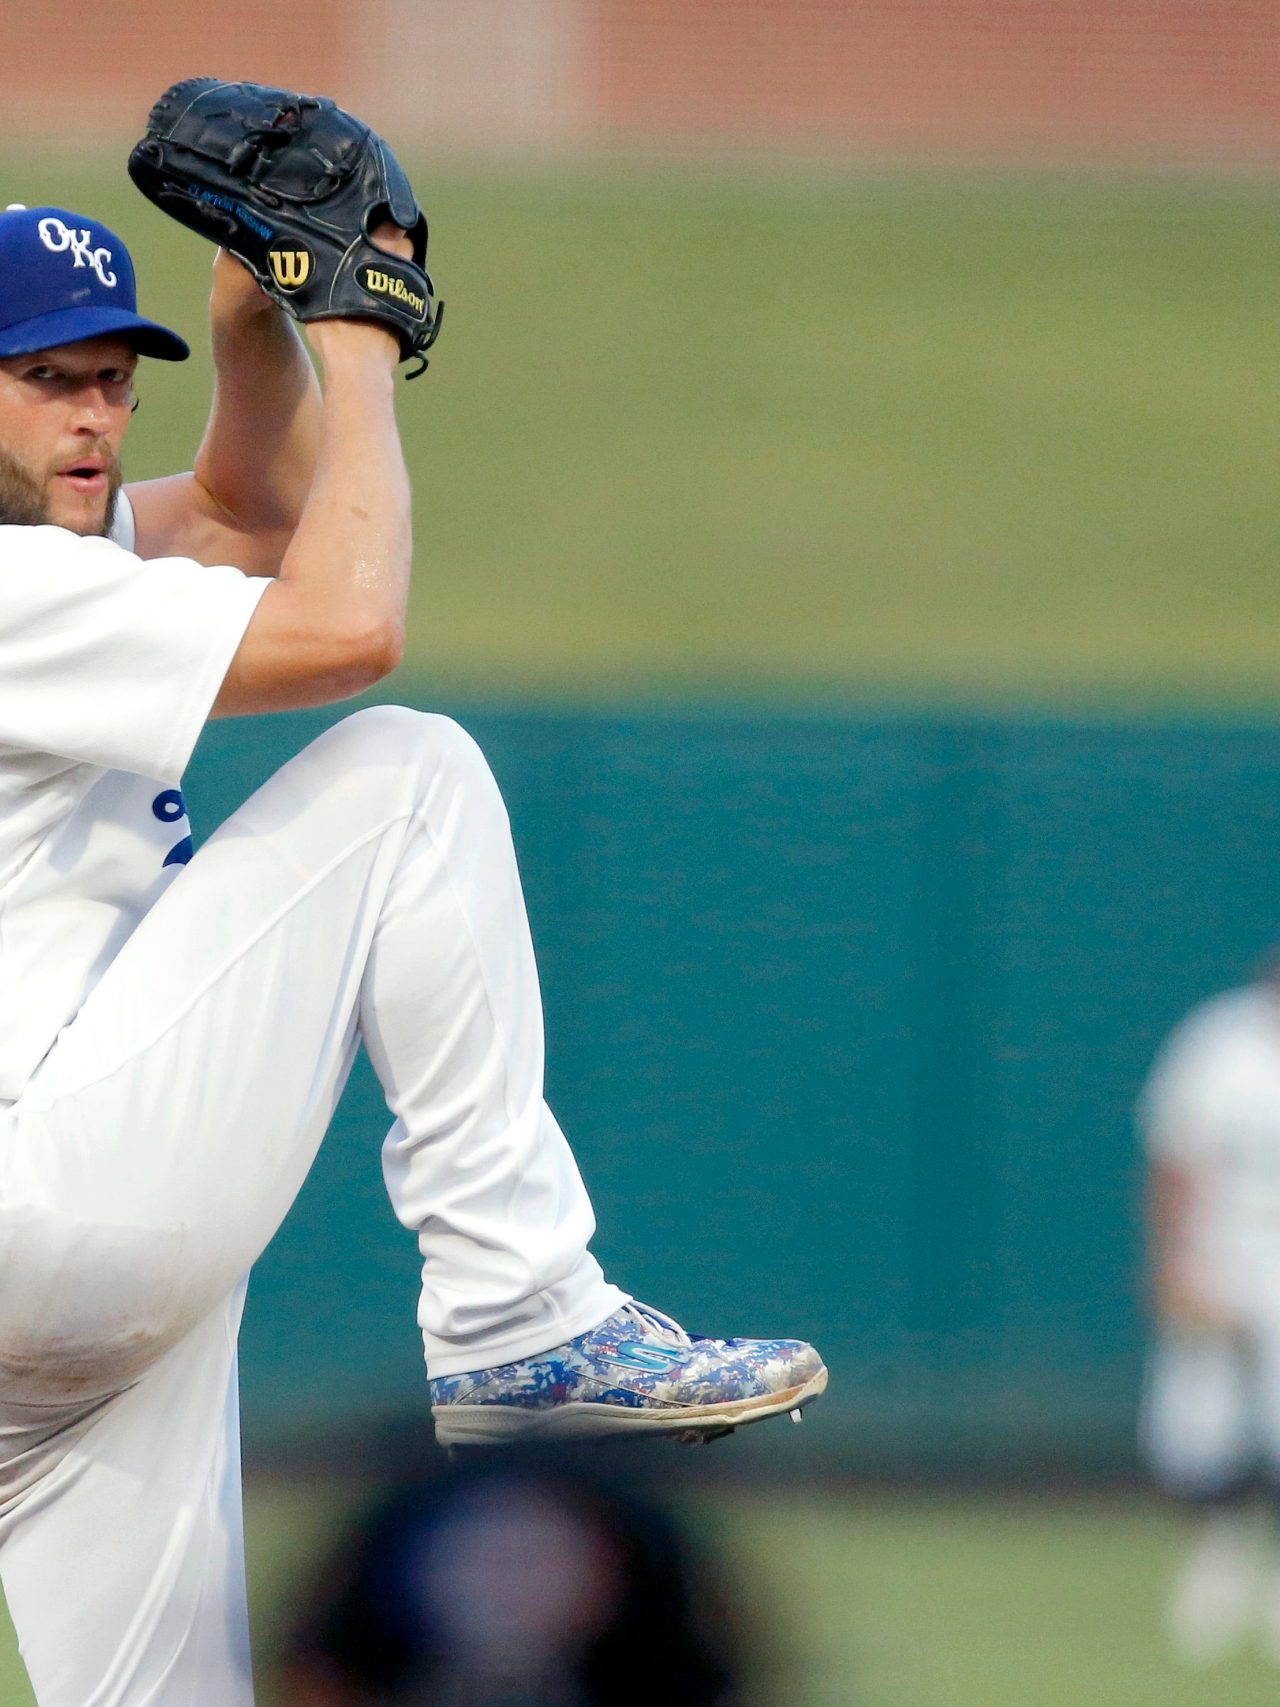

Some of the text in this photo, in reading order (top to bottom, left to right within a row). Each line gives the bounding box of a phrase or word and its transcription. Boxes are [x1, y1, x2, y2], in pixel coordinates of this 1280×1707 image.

[37, 217, 117, 288] OKC
[270, 251, 309, 286] W
[366, 269, 425, 314] Wilson
